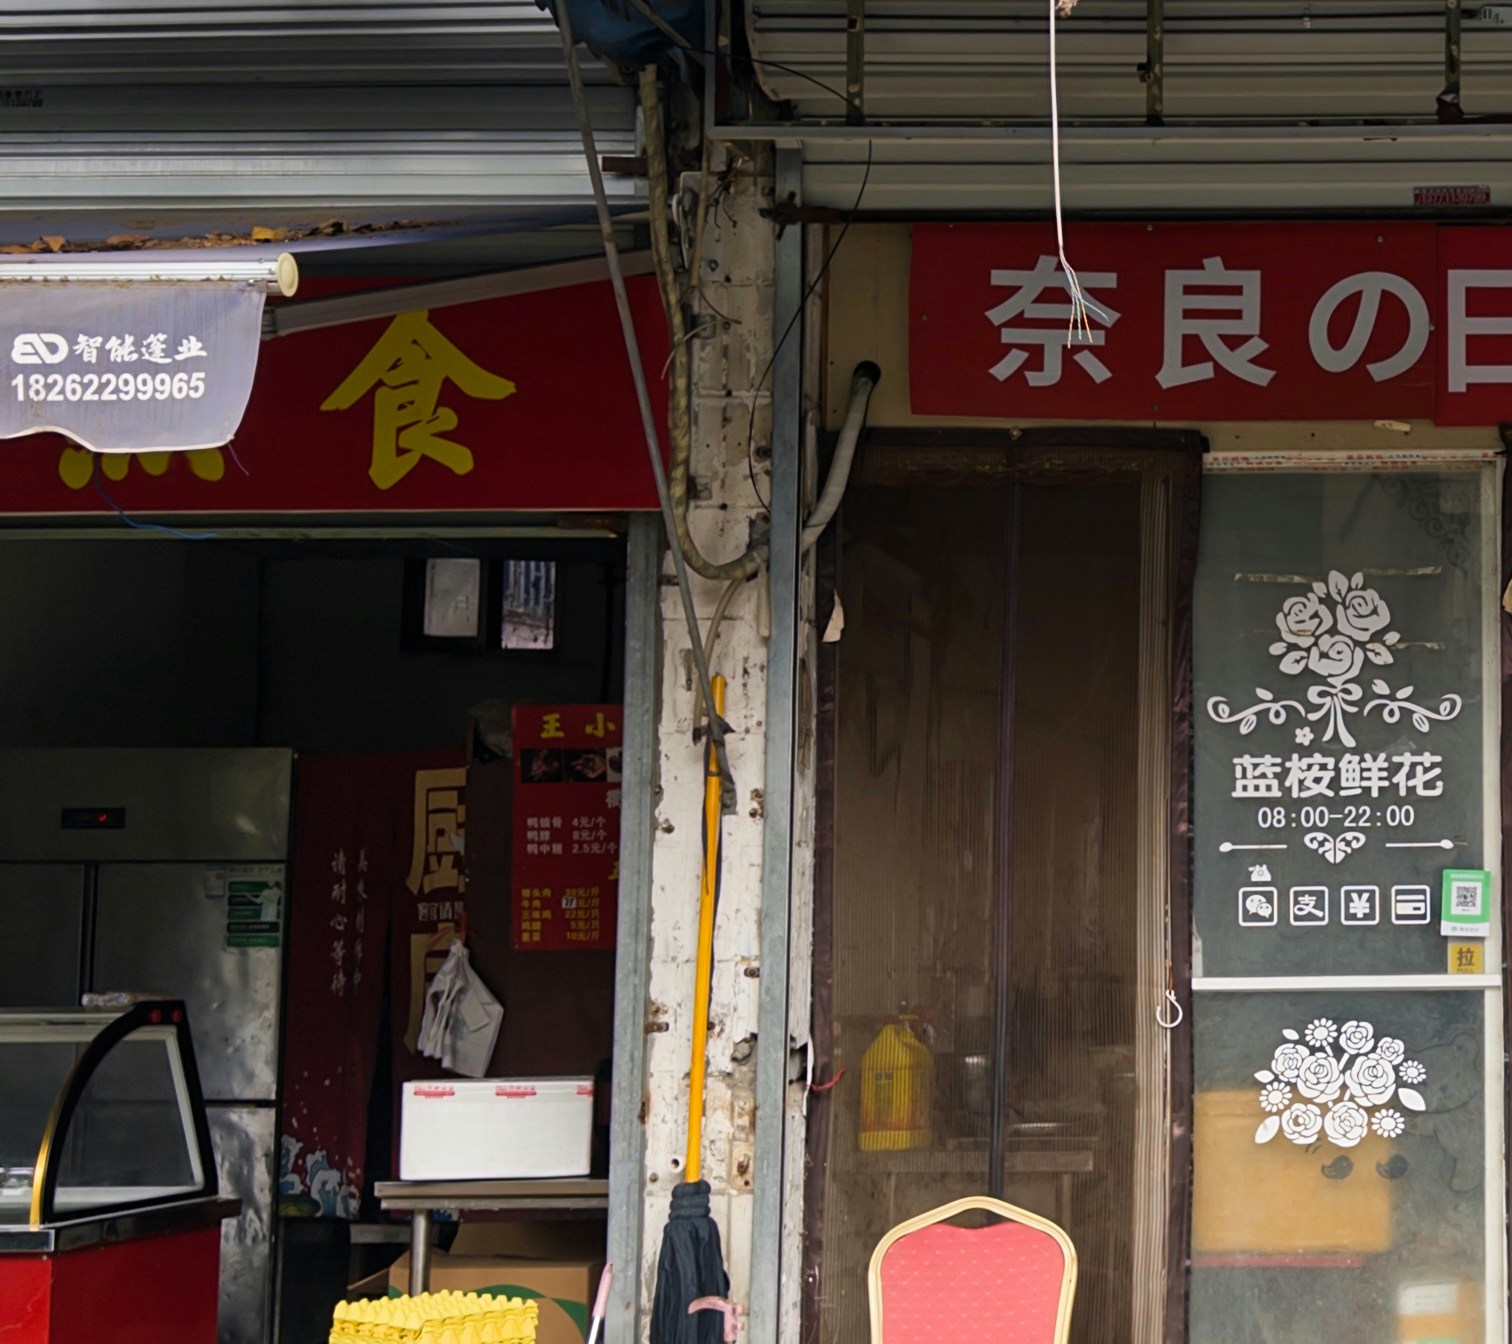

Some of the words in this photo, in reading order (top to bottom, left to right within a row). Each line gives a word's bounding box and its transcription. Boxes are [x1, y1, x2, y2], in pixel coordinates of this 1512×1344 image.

[11, 373, 206, 401] 18262299965
[1232, 753, 1443, 798] 蓝桉鲜花
[1258, 805, 1415, 828] 08:00-22:00
[1456, 947, 1475, 967] 拉
